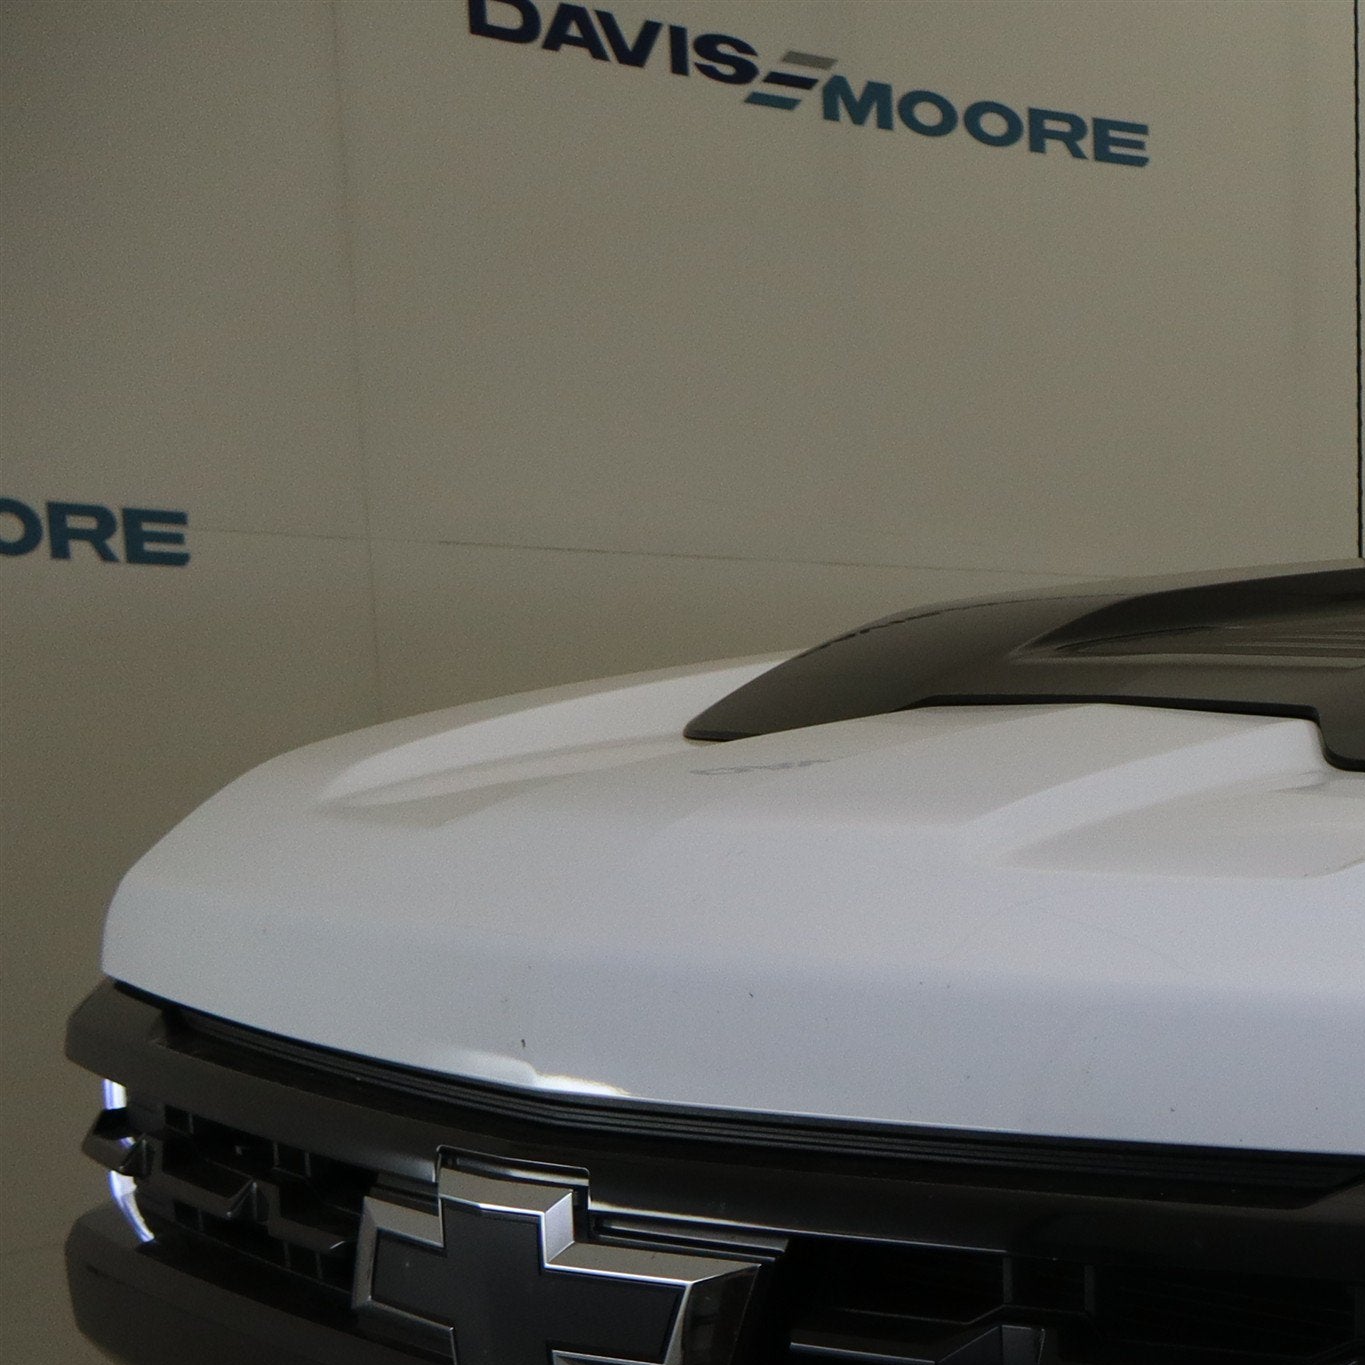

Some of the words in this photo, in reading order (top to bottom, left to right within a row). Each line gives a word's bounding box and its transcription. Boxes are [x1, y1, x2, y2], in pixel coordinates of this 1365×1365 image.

[468, 0, 760, 85] DAVIS
[822, 75, 1150, 168] MOORE
[0, 497, 191, 567] ORE
